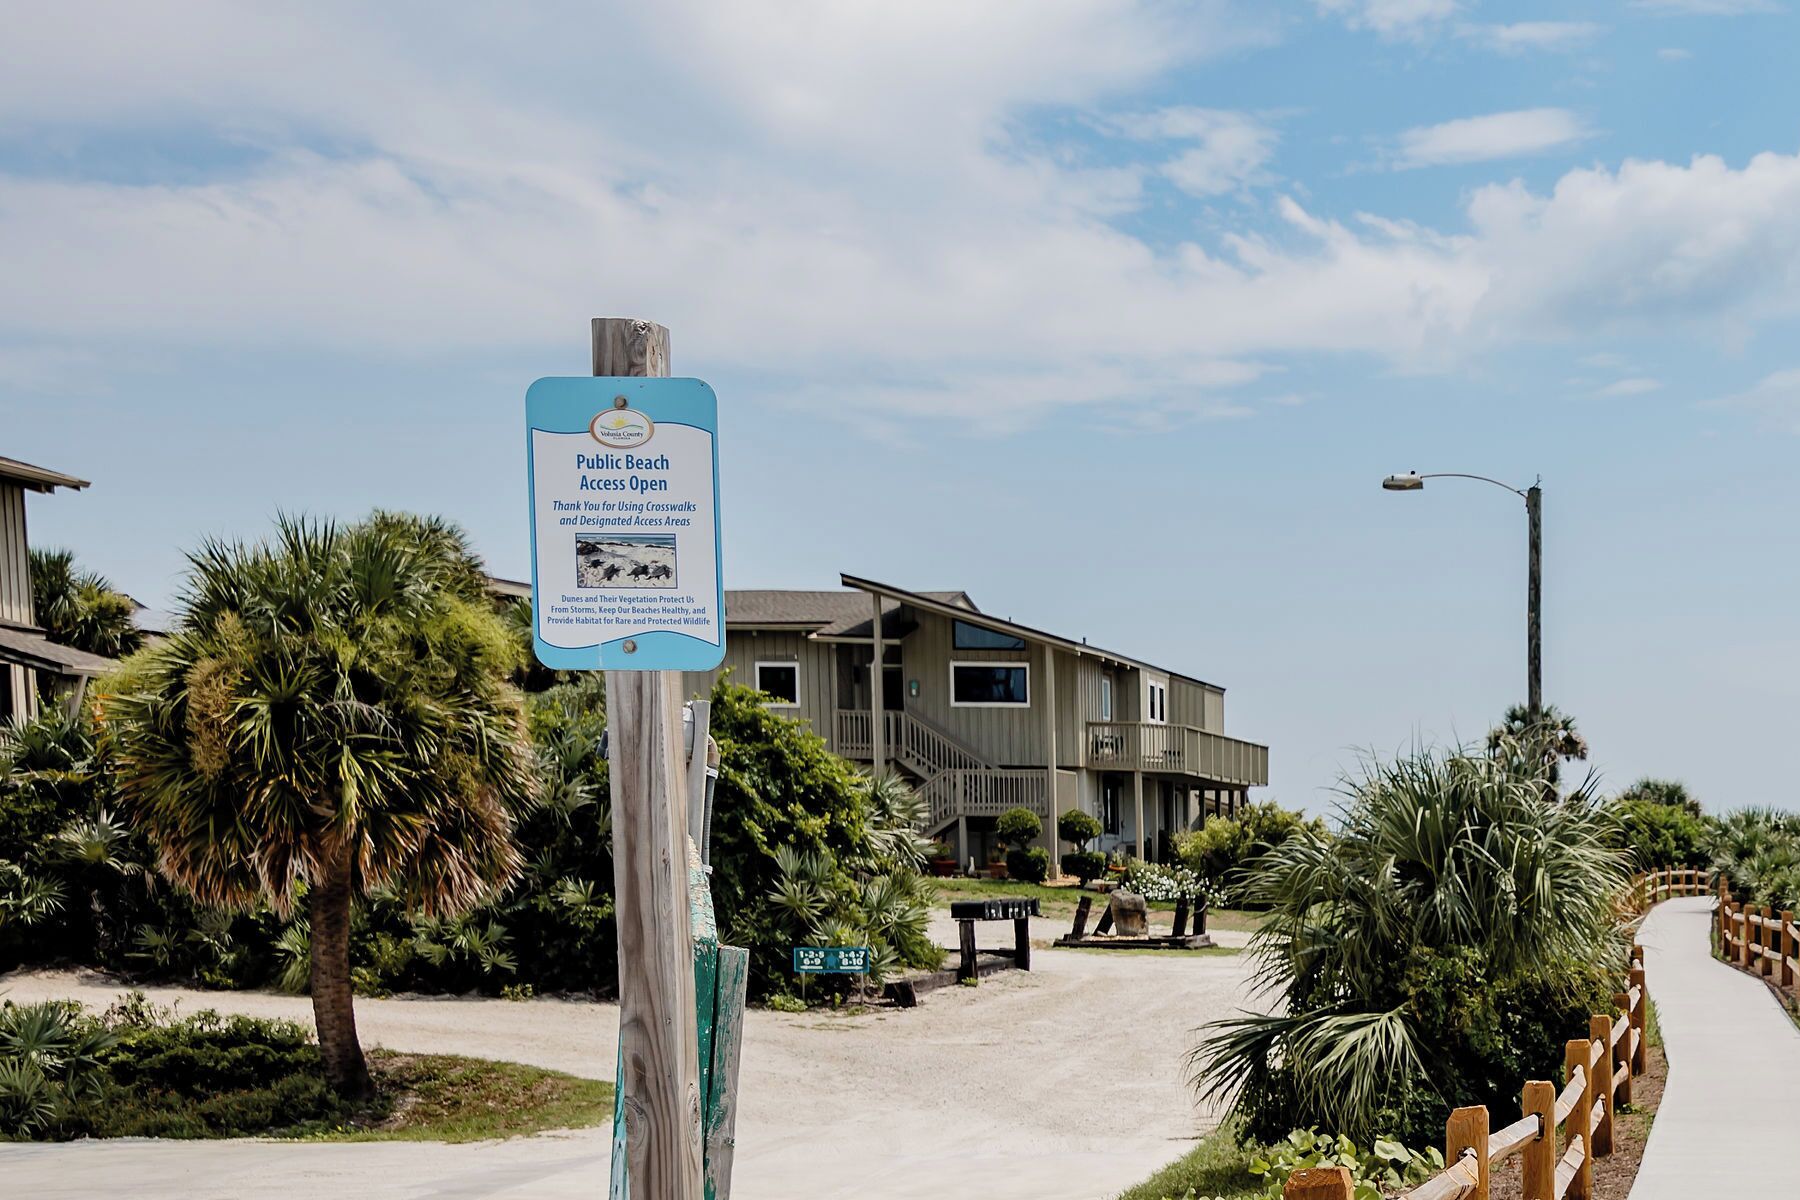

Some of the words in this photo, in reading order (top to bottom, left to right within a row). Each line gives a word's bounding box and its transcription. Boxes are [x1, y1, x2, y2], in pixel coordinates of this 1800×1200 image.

[577, 454, 622, 470] Public
[626, 454, 669, 470] Beach
[580, 475, 625, 490] Access
[630, 476, 667, 495] Open
[553, 500, 581, 511] Thank
[584, 501, 600, 511] You
[602, 501, 616, 511] for
[618, 501, 644, 514] Using
[646, 501, 696, 512] Crosswalks
[560, 515, 578, 525] and
[580, 516, 632, 528] Designated
[634, 516, 662, 526] Access
[664, 516, 690, 526] Areas
[619, 595, 658, 605] Vegetation
[570, 606, 597, 614] Storms,
[599, 606, 616, 615] Keep
[662, 606, 691, 616] Healthy,
